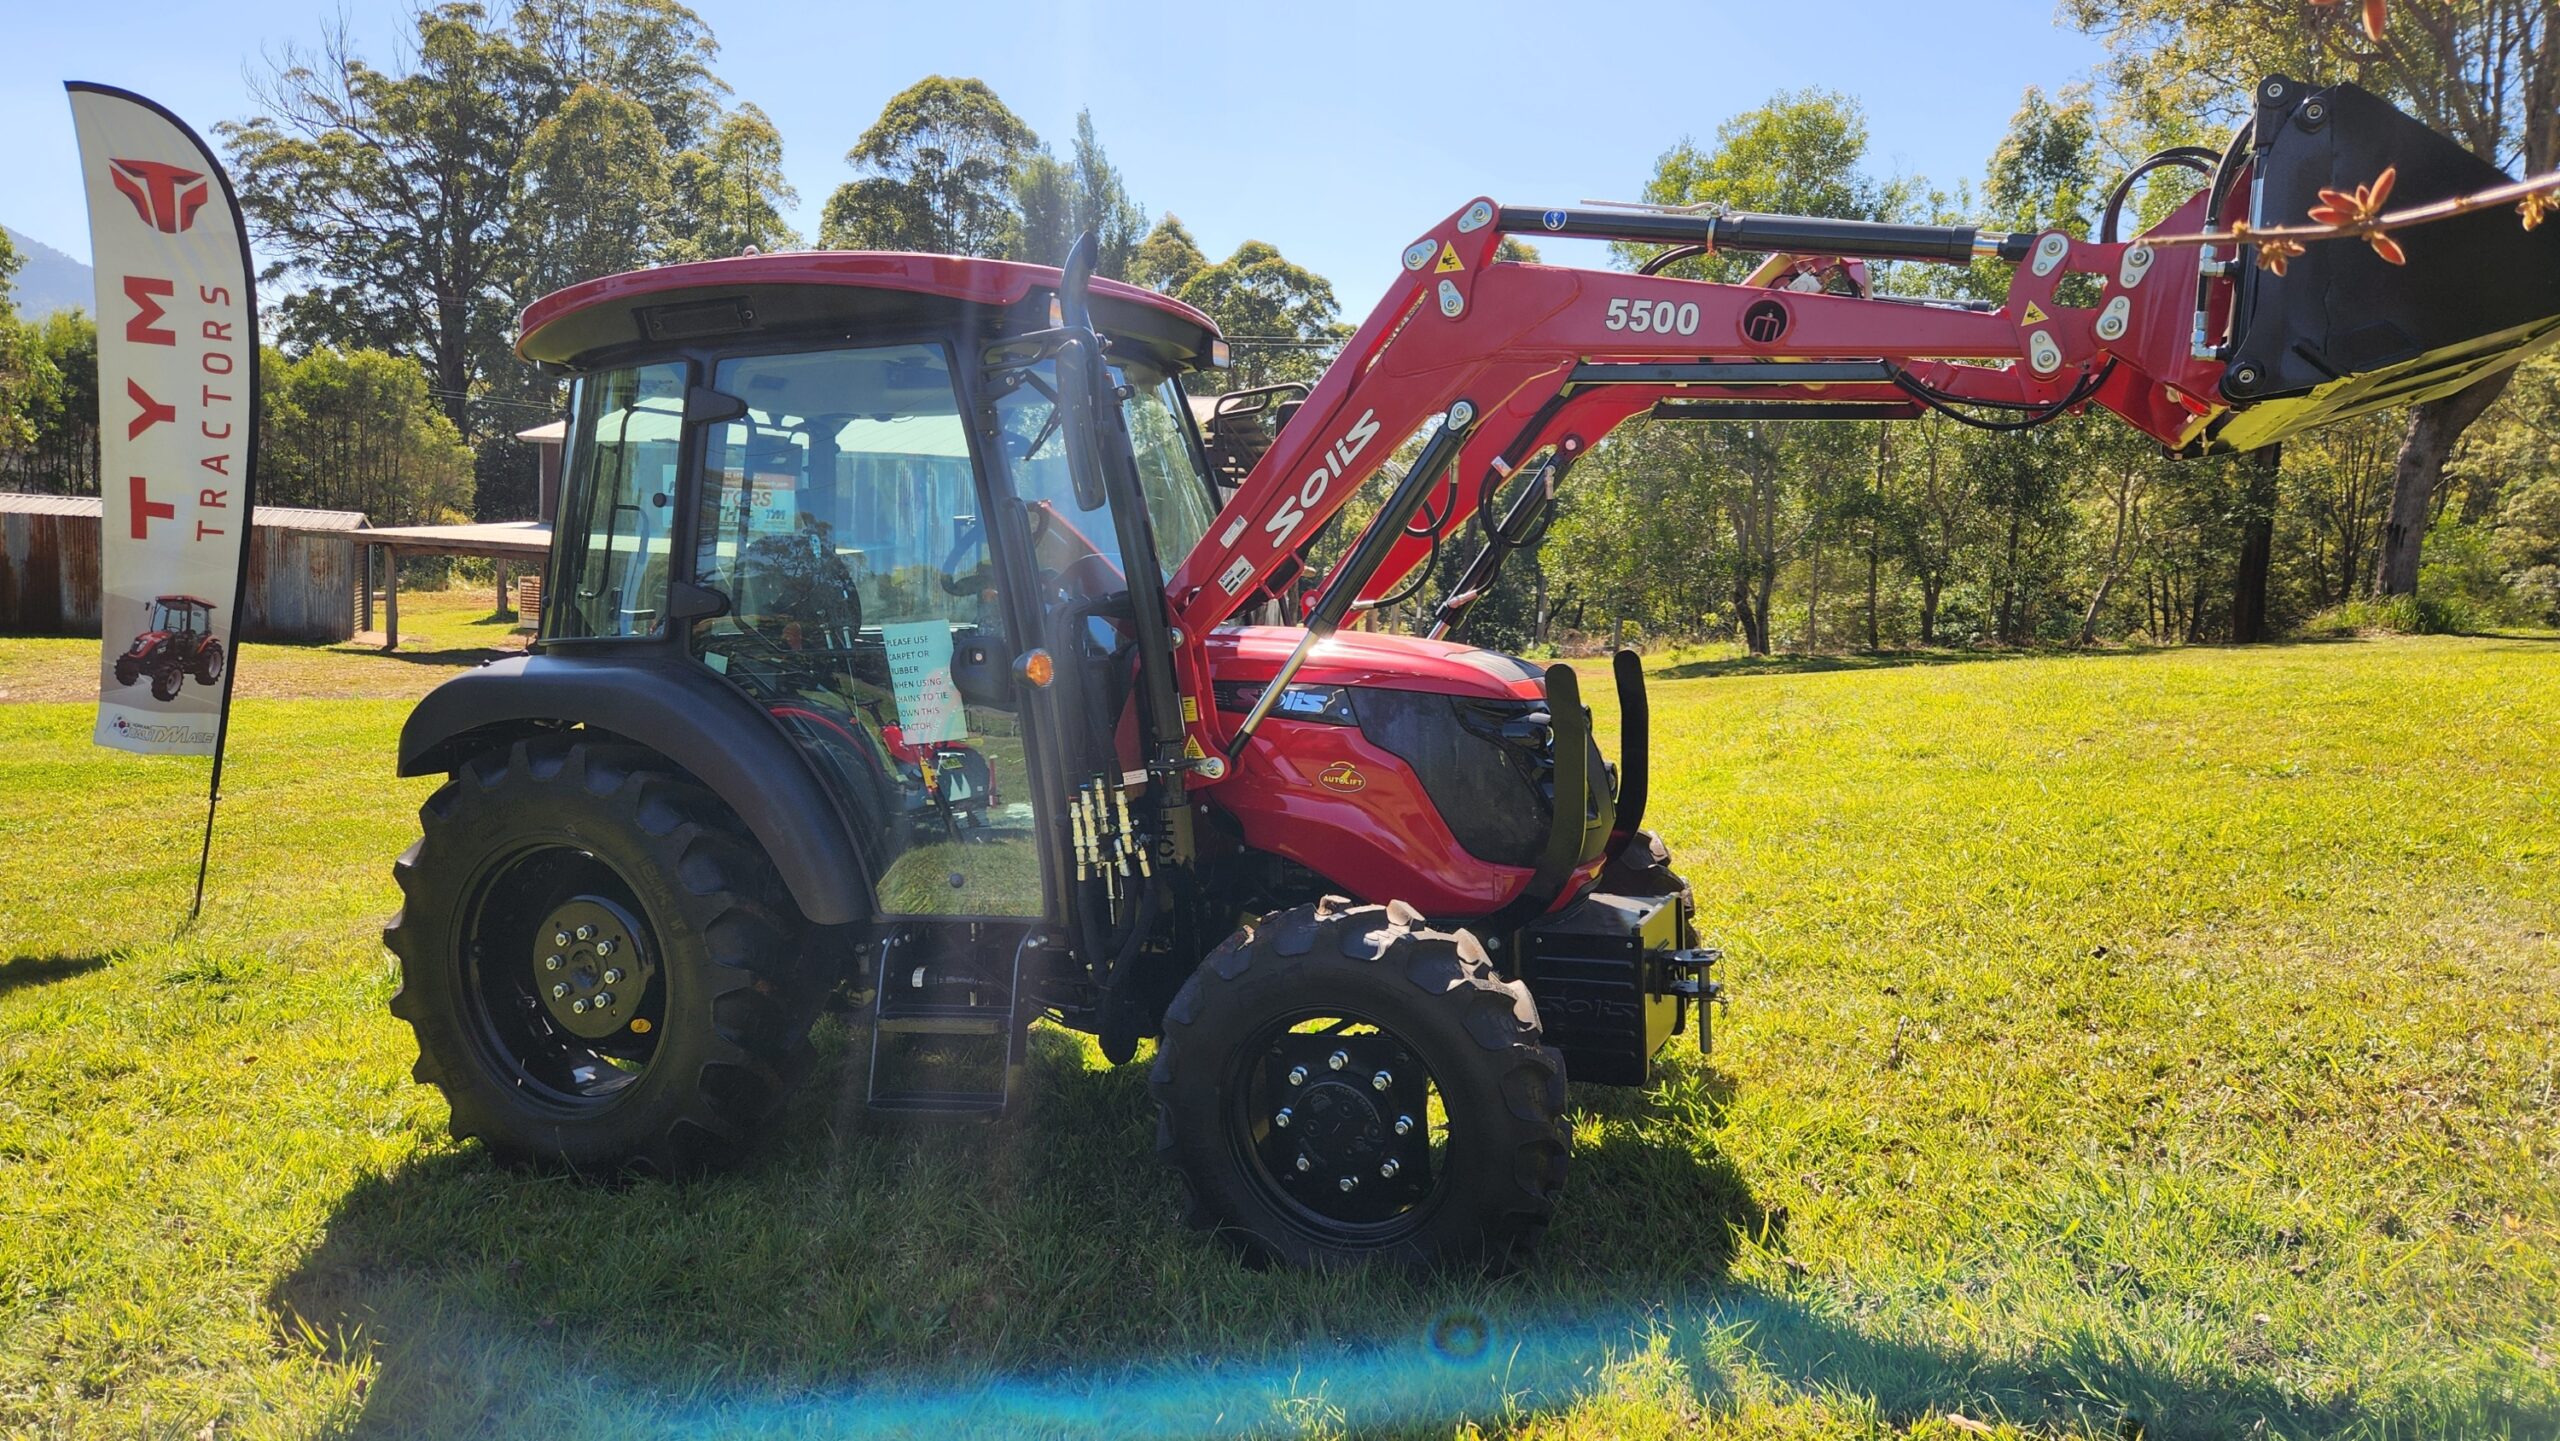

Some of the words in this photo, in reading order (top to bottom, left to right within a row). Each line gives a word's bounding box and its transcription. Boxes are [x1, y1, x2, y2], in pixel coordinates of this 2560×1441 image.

[1605, 297, 1699, 336] 5500
[124, 275, 176, 540] TYM
[196, 285, 233, 542] TRACTORS
[914, 635, 929, 645] USE
[888, 651, 915, 662] CARPET
[917, 650, 930, 658] OR
[916, 677, 942, 687] USING
[922, 692, 934, 701] TO
[936, 691, 949, 700] TIE
[921, 706, 940, 716] THIS
